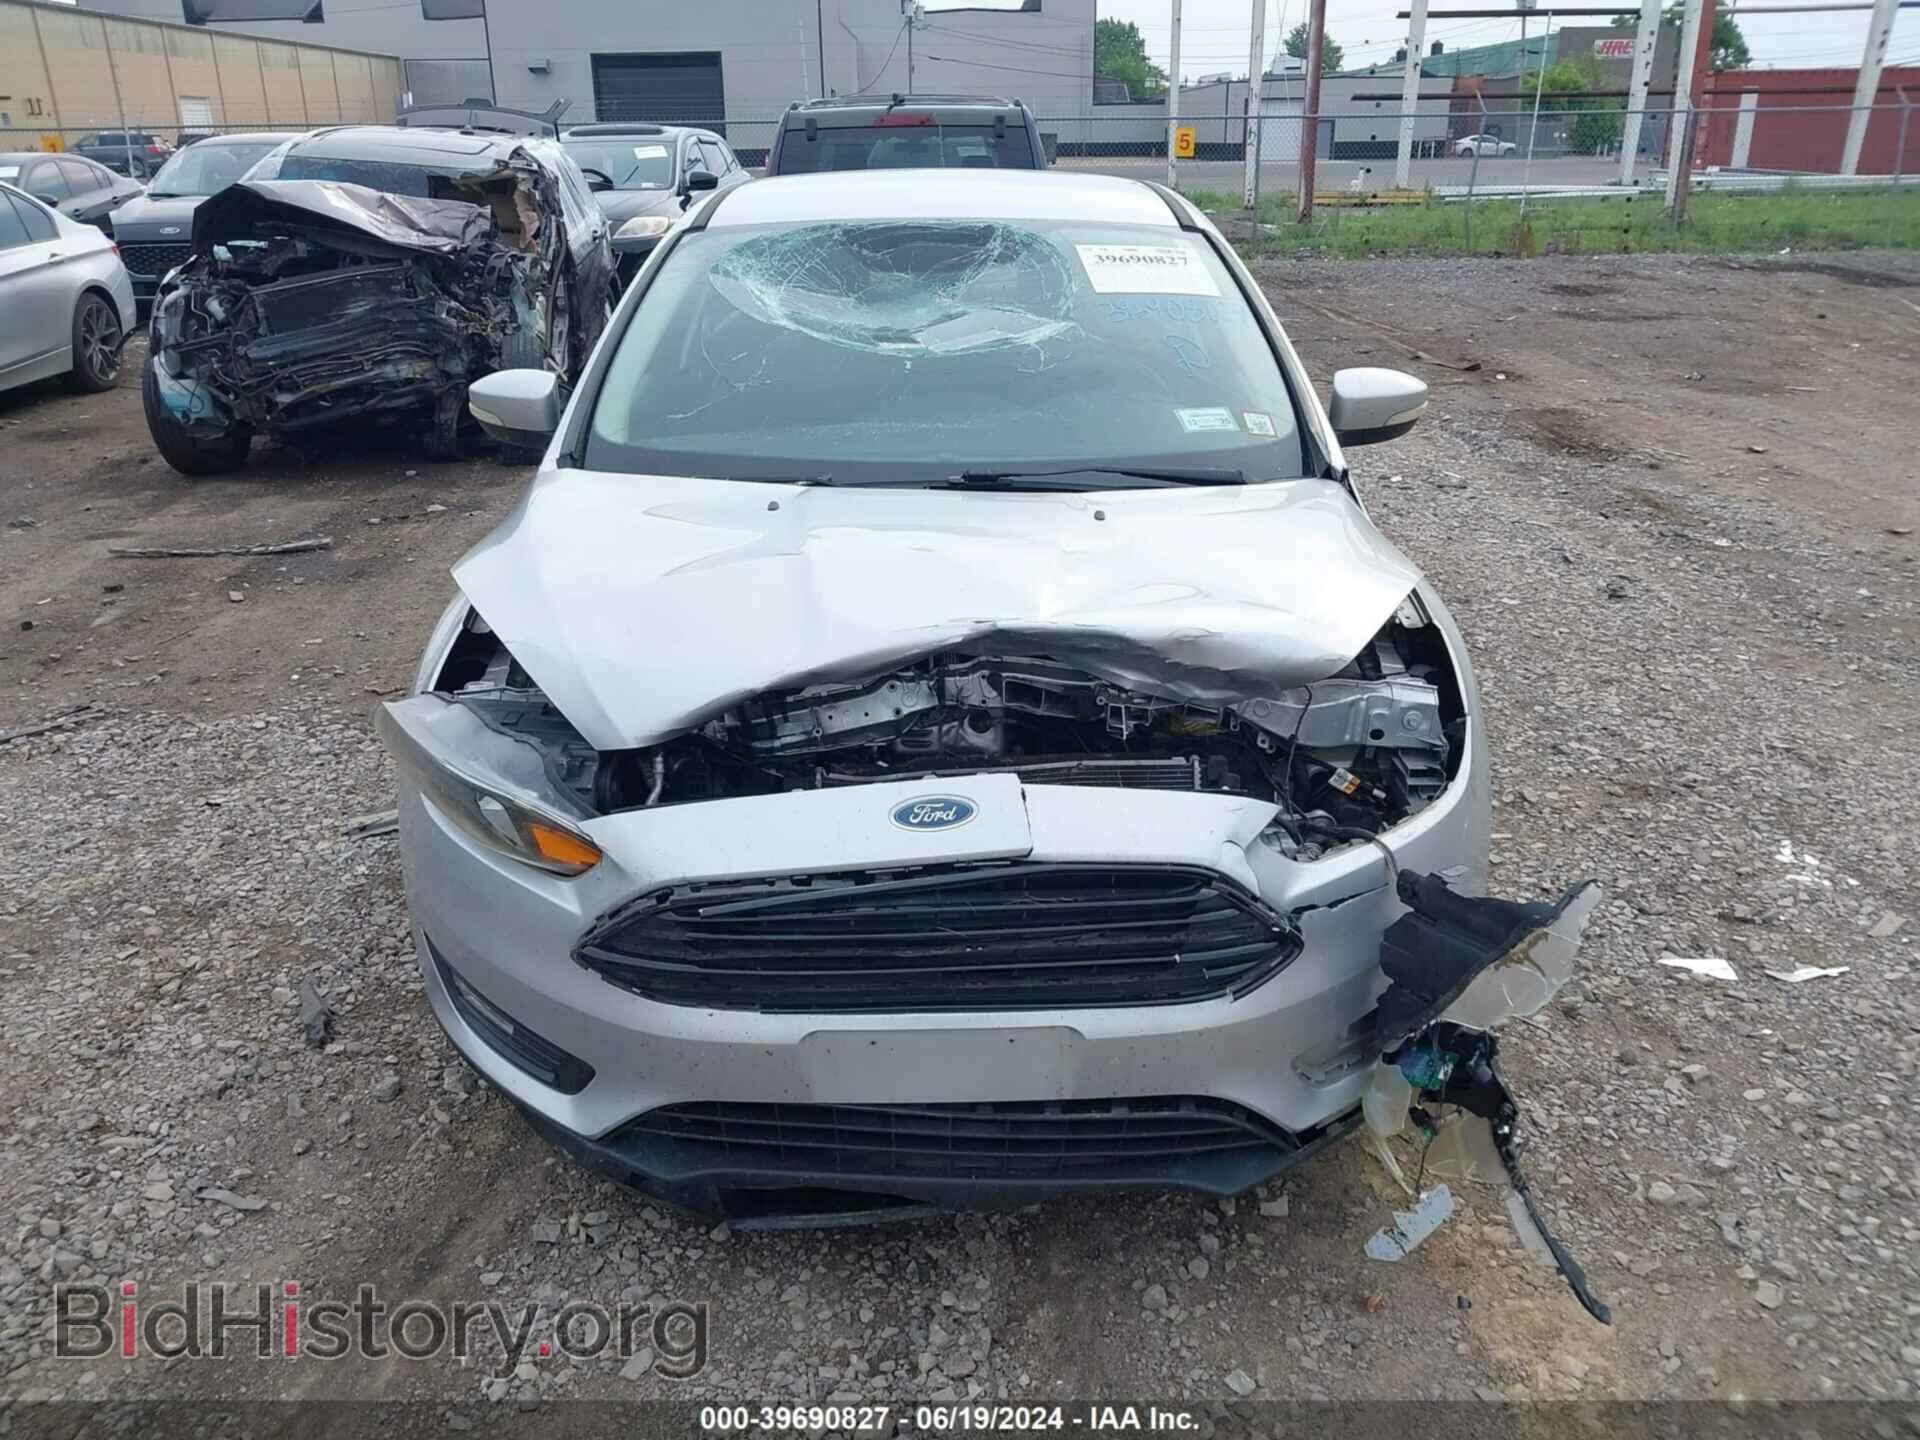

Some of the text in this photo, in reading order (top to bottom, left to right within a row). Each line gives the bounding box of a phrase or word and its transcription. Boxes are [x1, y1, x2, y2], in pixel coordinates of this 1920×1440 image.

[1179, 133, 1191, 151] 5
[1096, 254, 1188, 266] 39690827
[910, 803, 957, 824] Ford
